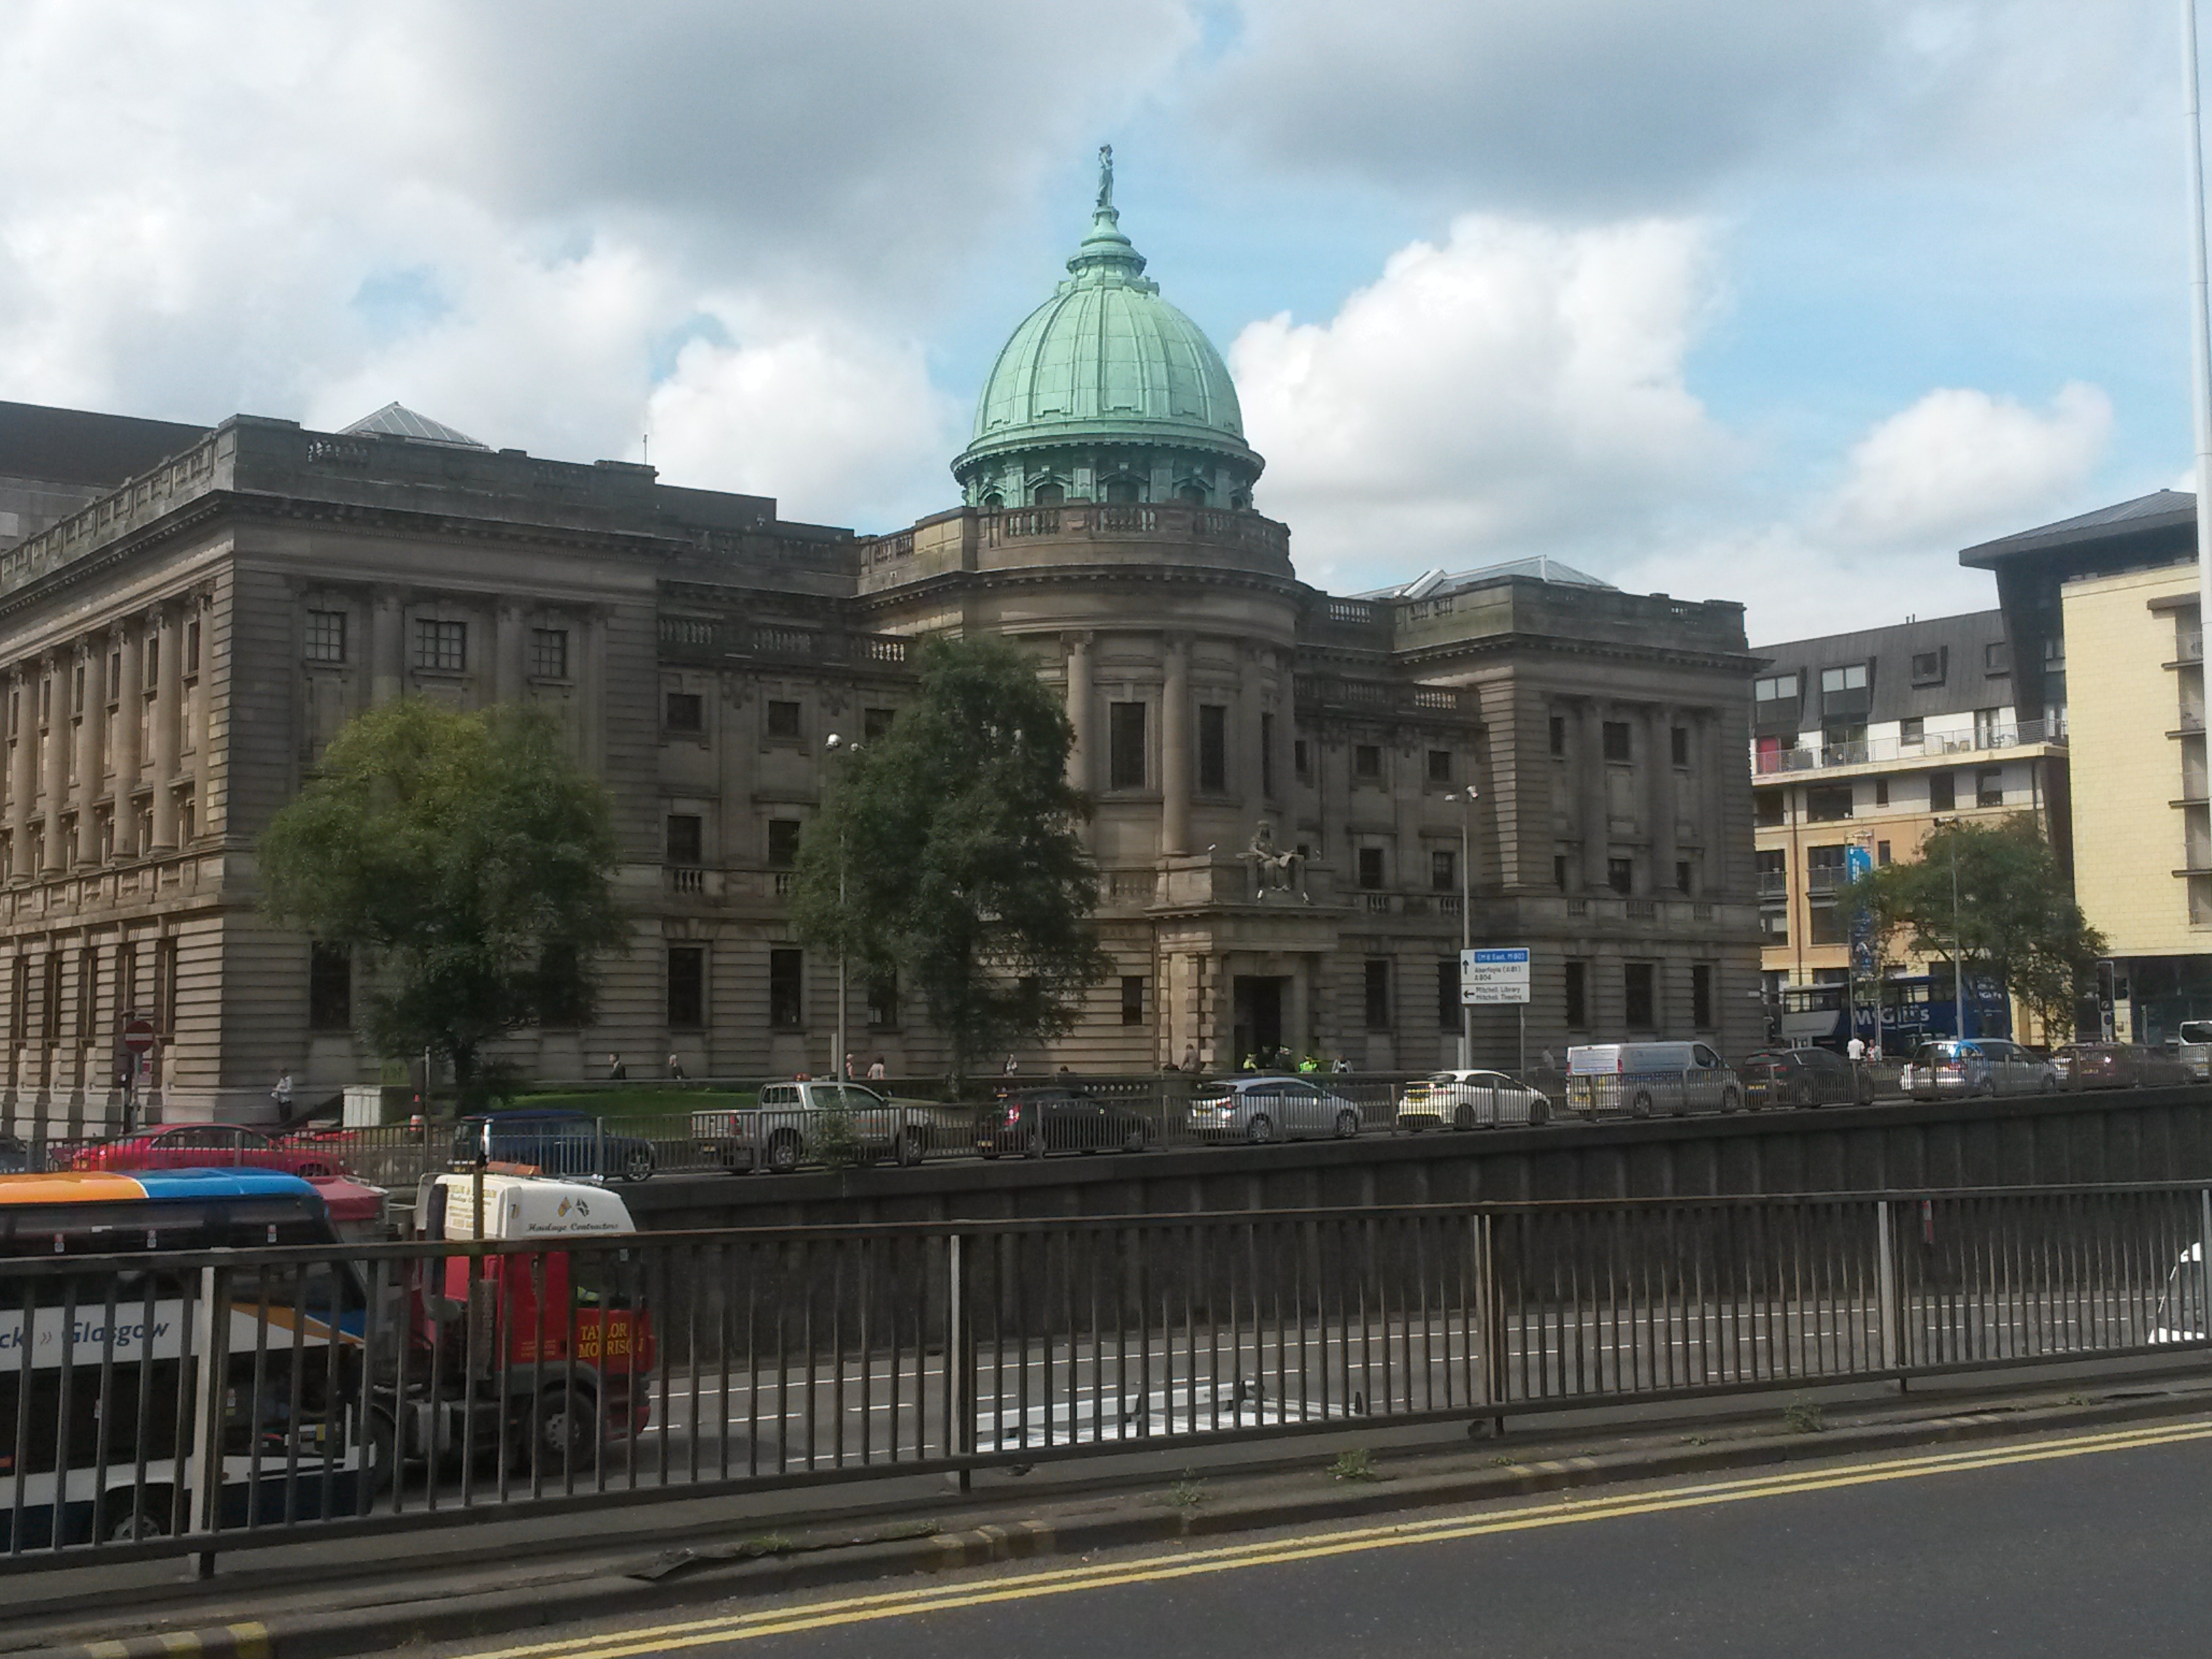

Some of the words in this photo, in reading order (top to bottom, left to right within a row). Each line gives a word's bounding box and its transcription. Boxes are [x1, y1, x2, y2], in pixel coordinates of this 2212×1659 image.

[526, 1223, 567, 1233] Haulage
[571, 1222, 619, 1231] Contractors
[62, 1322, 170, 1347] Glagow
[581, 1322, 627, 1340] TAOR
[578, 1338, 644, 1358] MORISO
